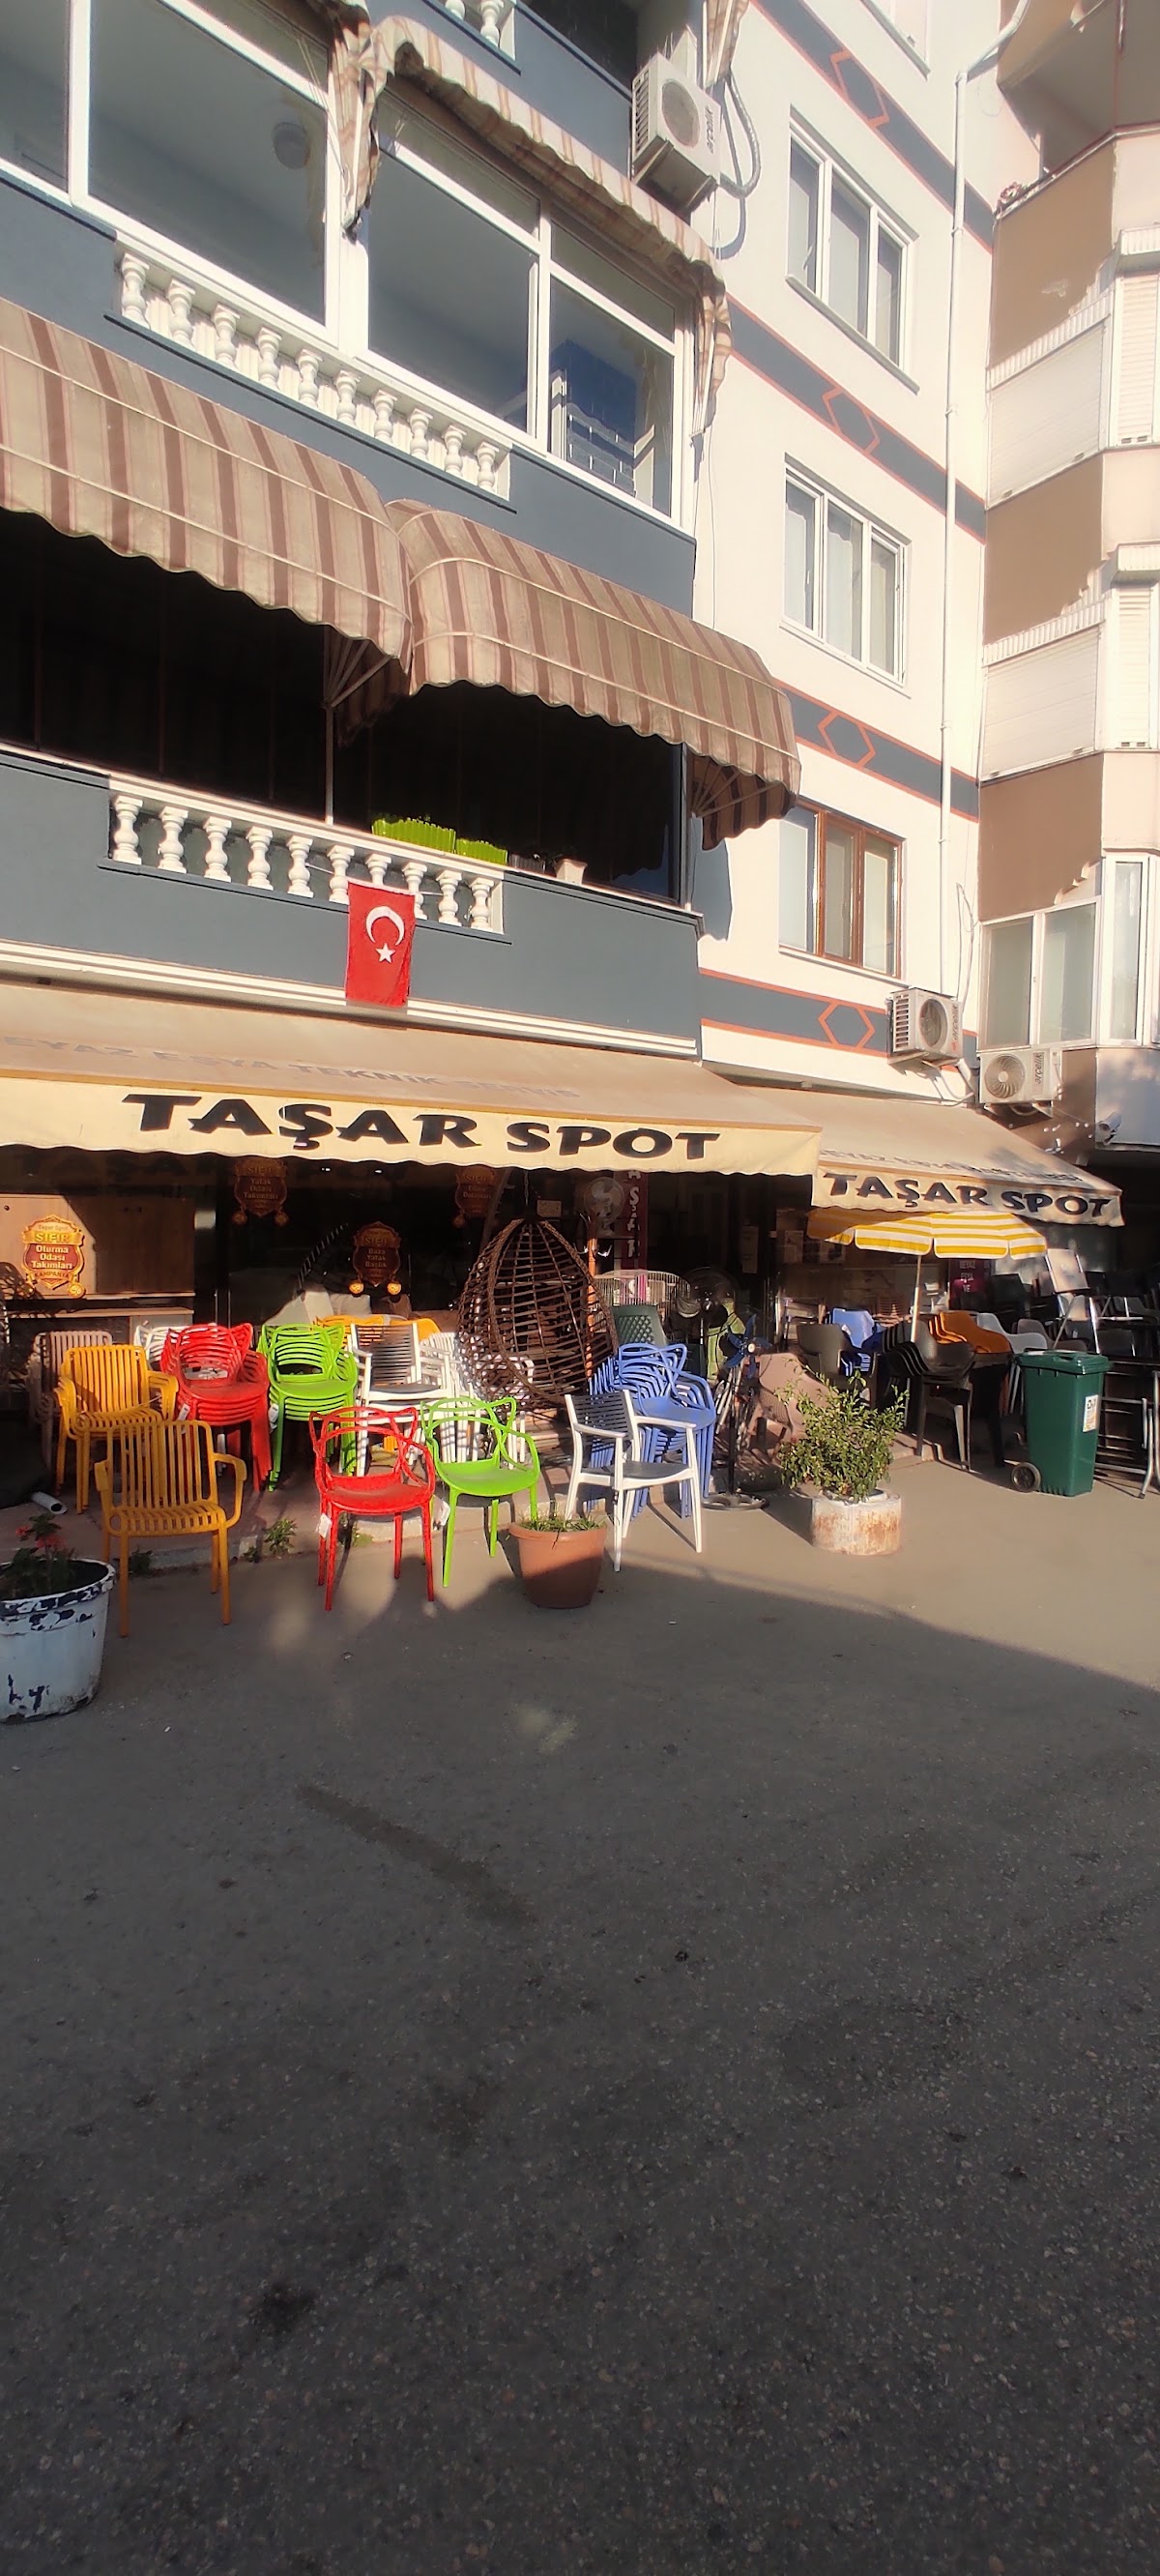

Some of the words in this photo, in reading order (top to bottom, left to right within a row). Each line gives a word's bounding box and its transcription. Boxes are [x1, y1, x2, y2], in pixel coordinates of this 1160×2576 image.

[4, 1037, 139, 1059] EYAZ
[1032, 1052, 1044, 1084] arçelik
[122, 1093, 481, 1151] TAŞAR
[506, 1121, 720, 1160] SPOT
[823, 1172, 992, 1208] TAŞAR
[1000, 1190, 1112, 1217] SPOT
[36, 1244, 70, 1253] Oturma
[31, 1260, 73, 1269] Takımları
